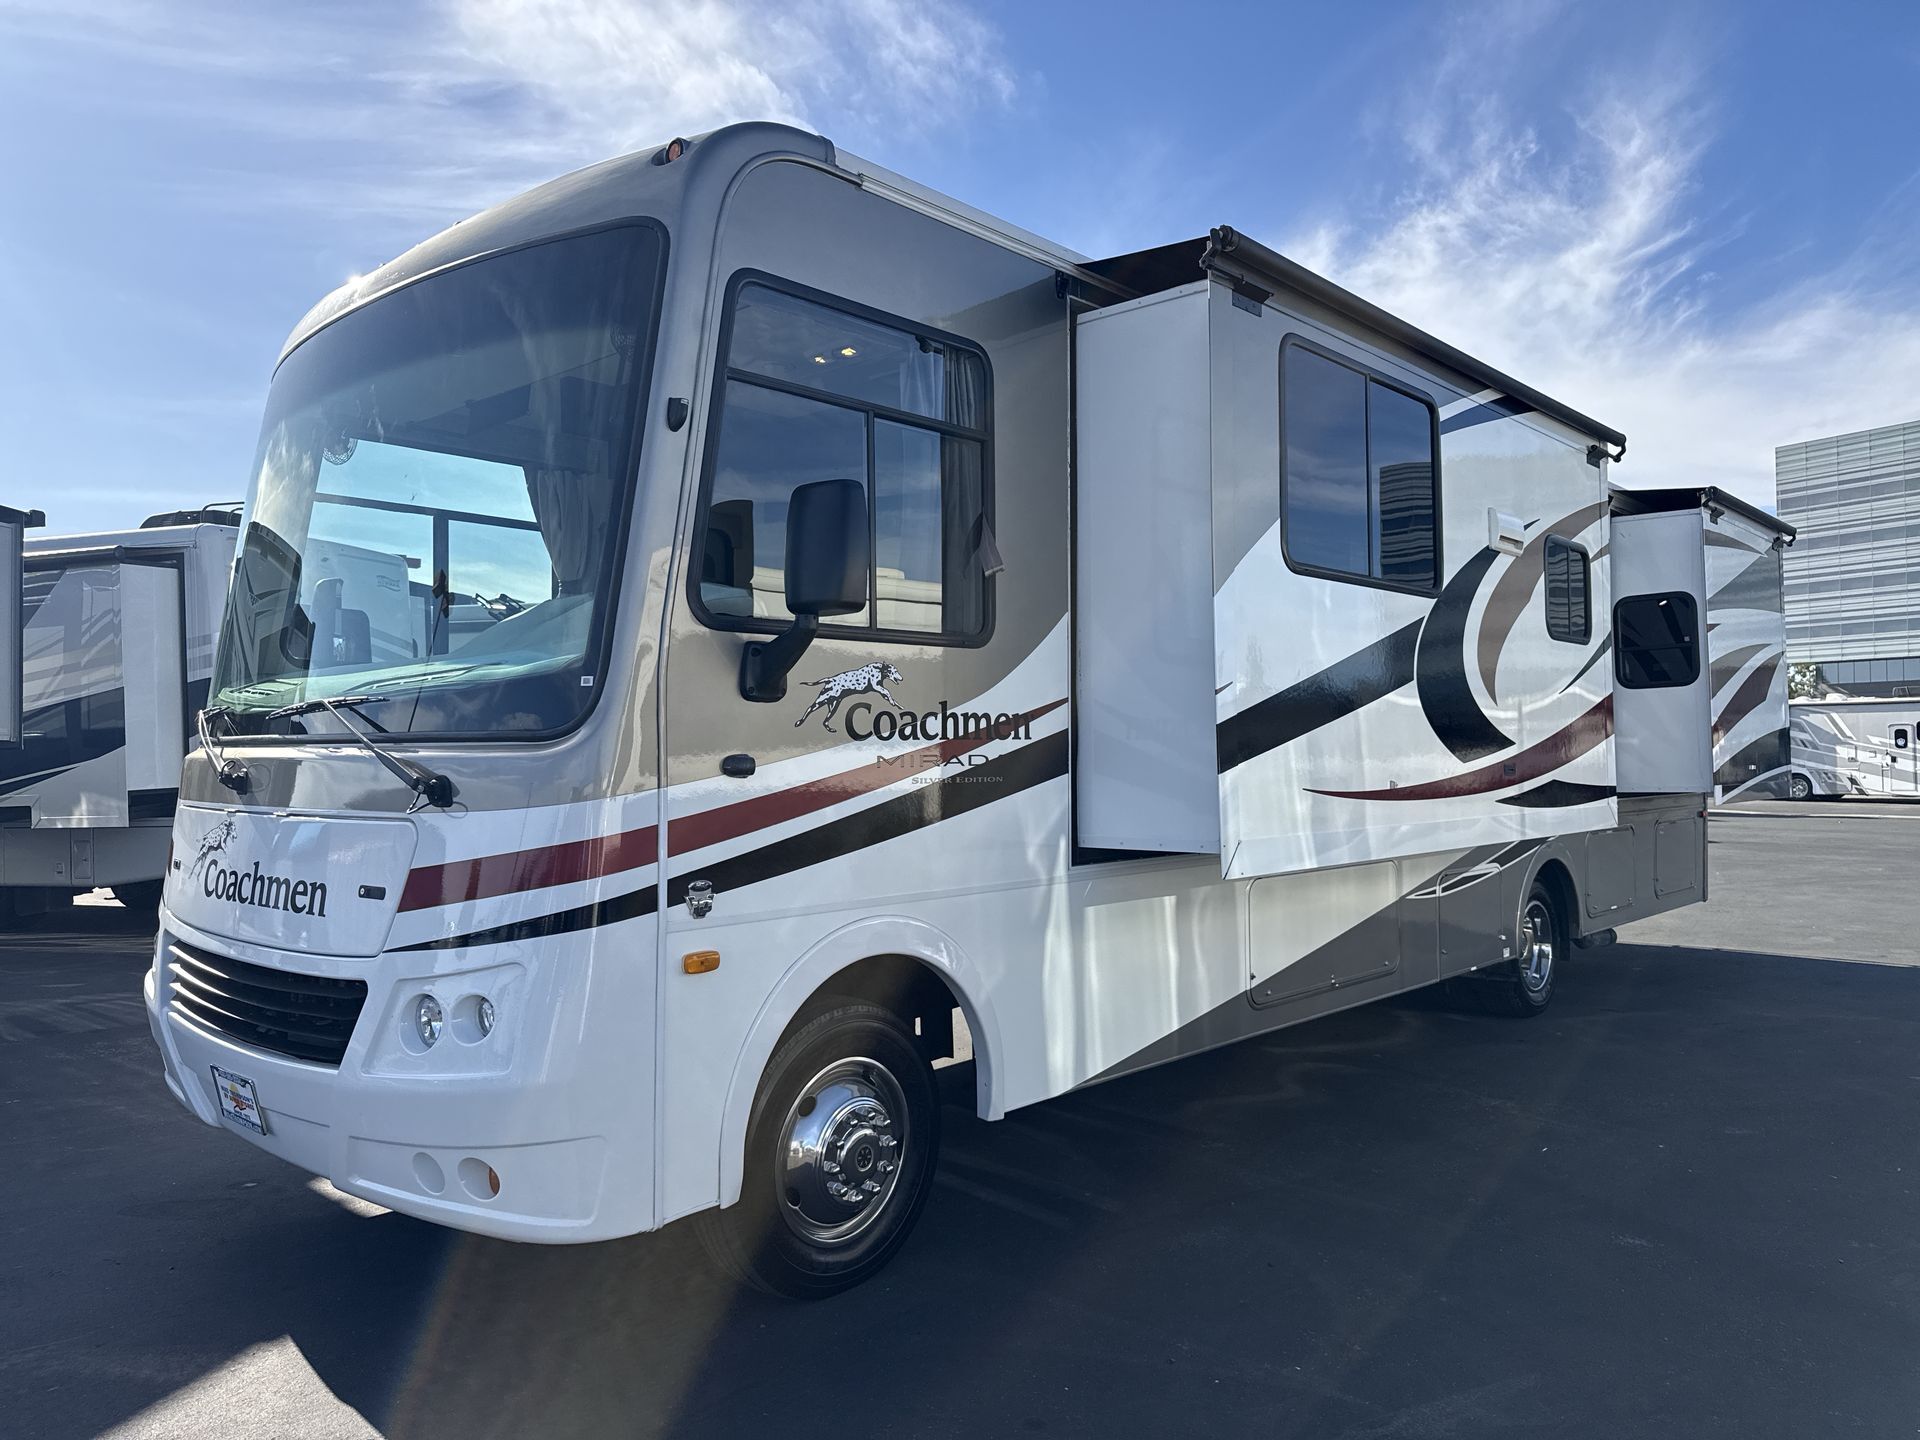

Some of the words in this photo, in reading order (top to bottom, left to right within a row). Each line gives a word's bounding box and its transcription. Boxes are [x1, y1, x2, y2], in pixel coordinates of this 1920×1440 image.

[845, 701, 1031, 741] Coachmen
[877, 754, 1005, 768] MIRAD
[911, 776, 953, 785] SILVER
[955, 776, 1004, 784] EDITION
[204, 859, 327, 917] Coachmen
